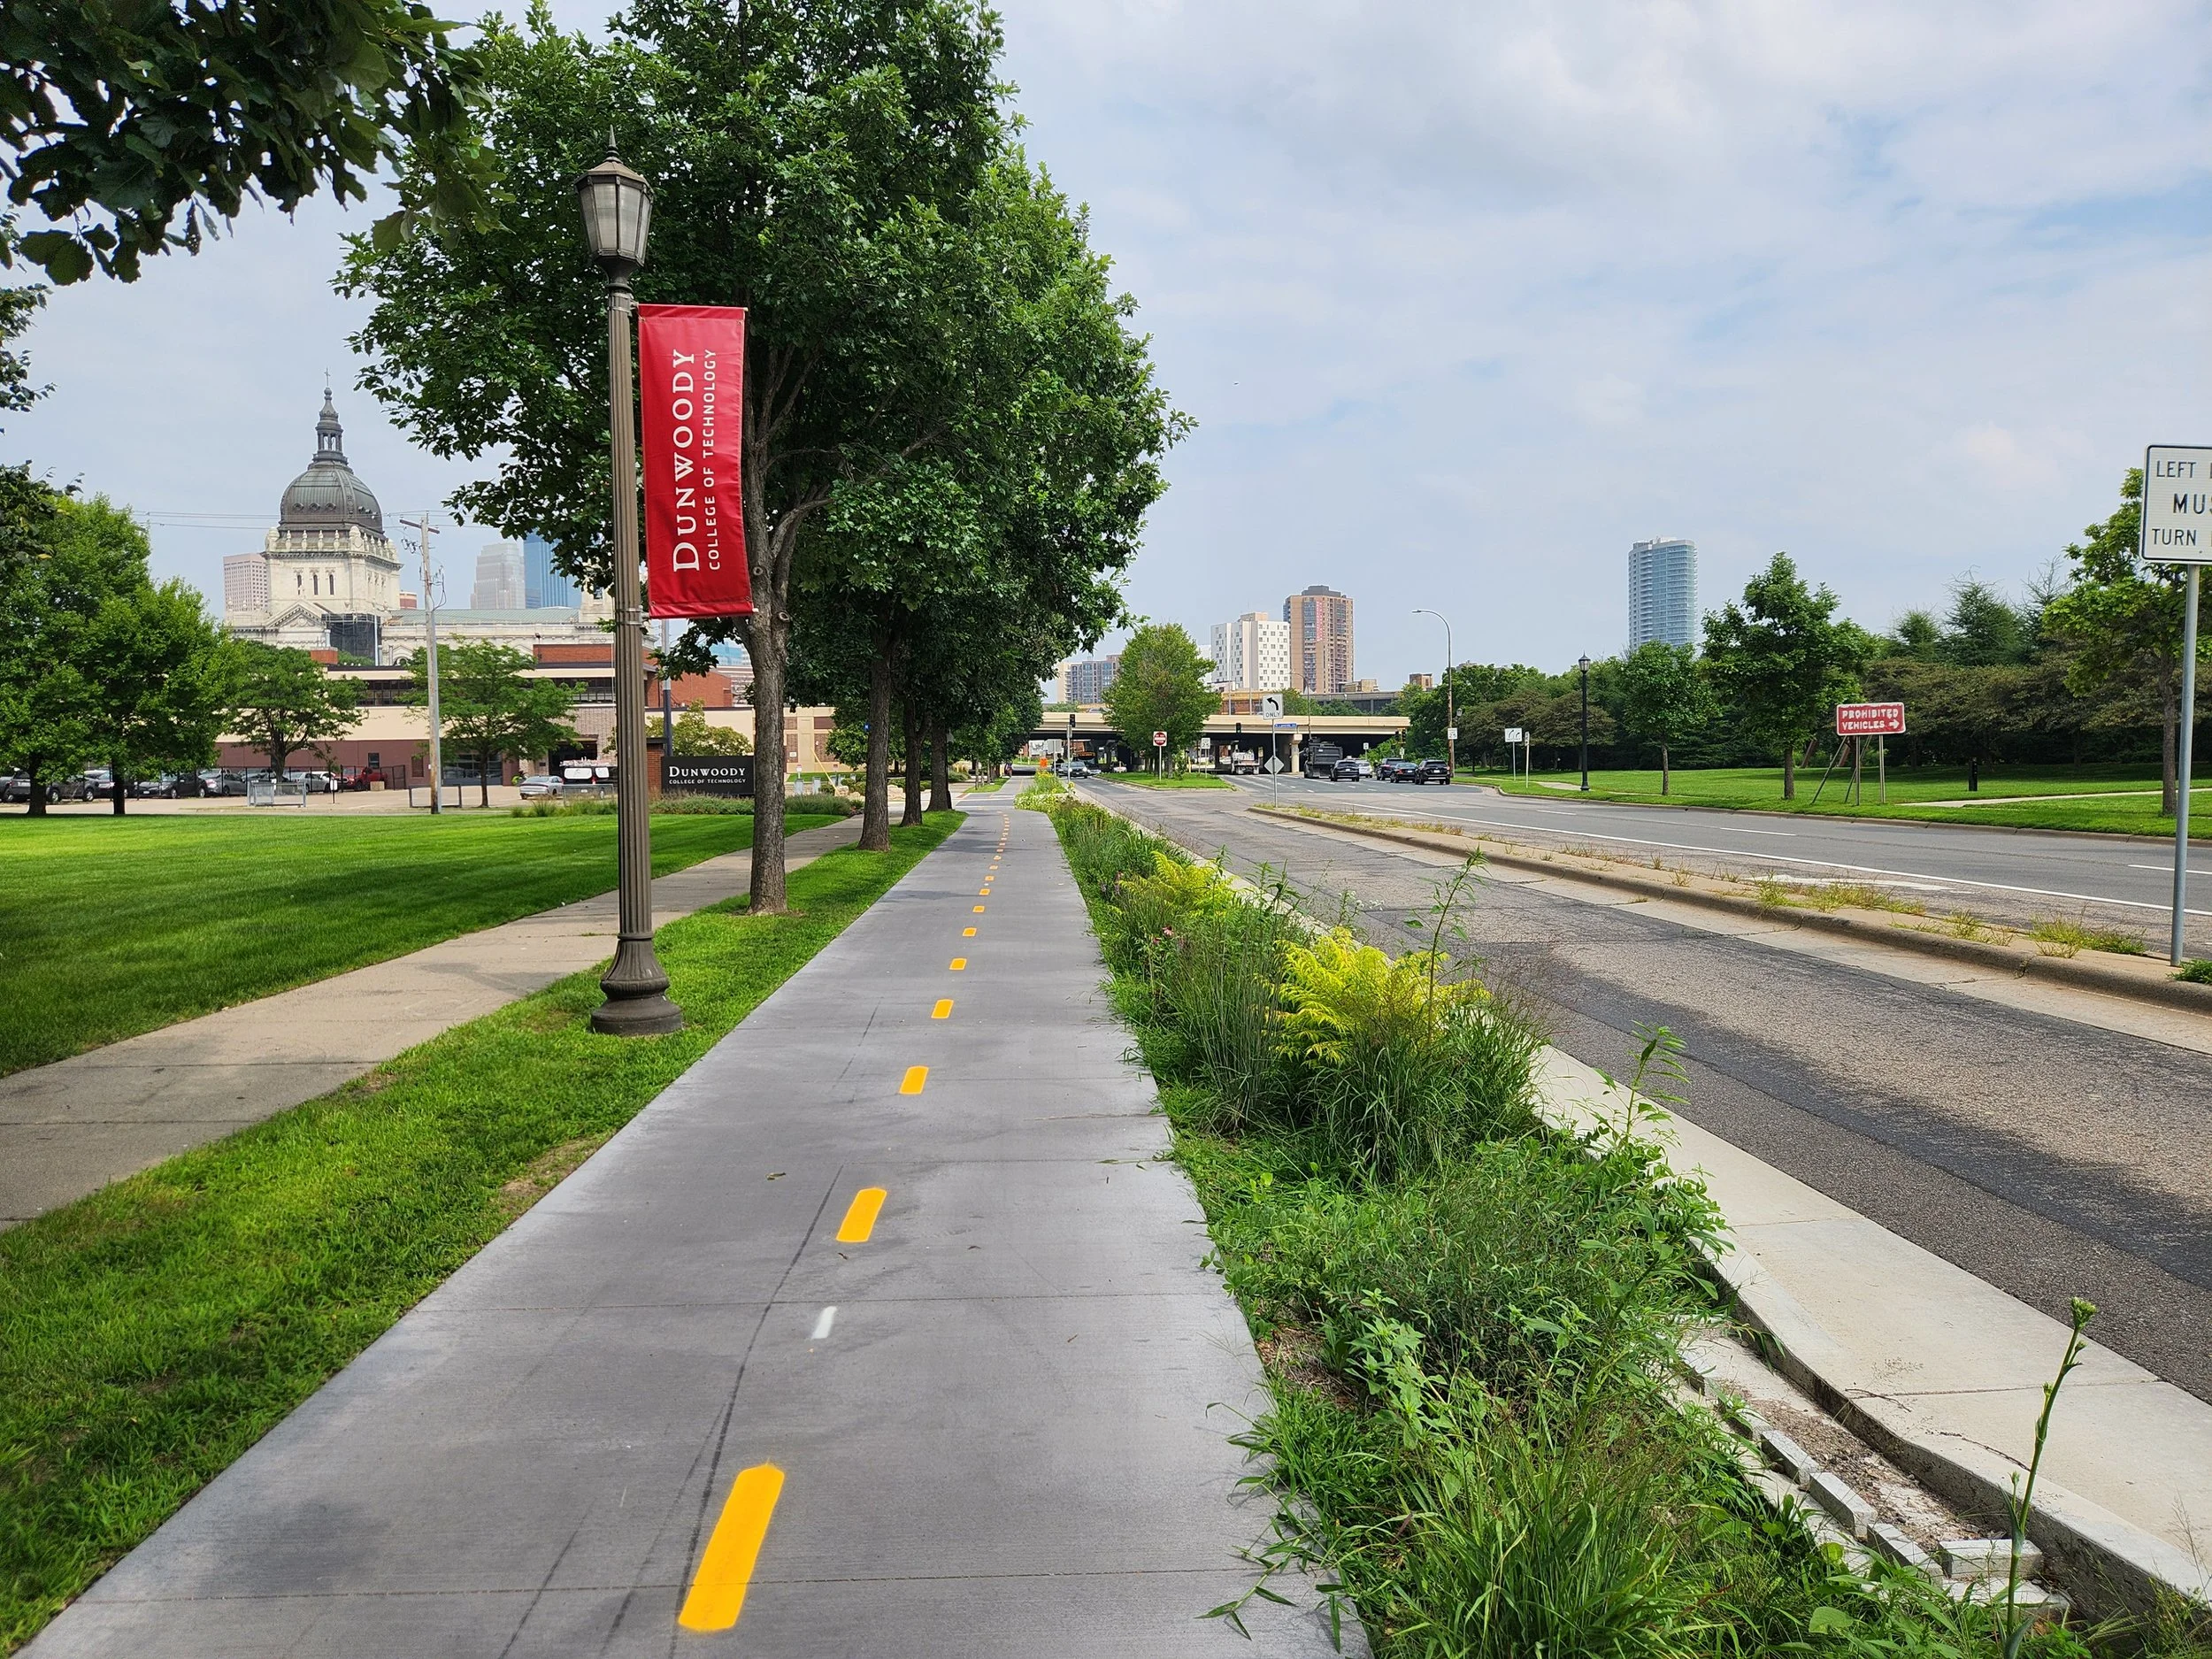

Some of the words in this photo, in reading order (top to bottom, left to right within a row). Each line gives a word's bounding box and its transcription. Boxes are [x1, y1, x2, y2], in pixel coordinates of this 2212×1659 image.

[702, 349, 717, 456] TECHNOLOGY
[672, 349, 700, 572] DUNWOODY
[2156, 460, 2196, 479] LEFT
[703, 467, 715, 488] OF
[2173, 493, 2212, 515] MU
[705, 495, 721, 571] COLLEGE
[2152, 528, 2197, 546] TURN
[1841, 708, 1899, 719] PROHIBITED
[1842, 720, 1886, 730] VEHICLES
[669, 765, 746, 777] DUNWOODY
